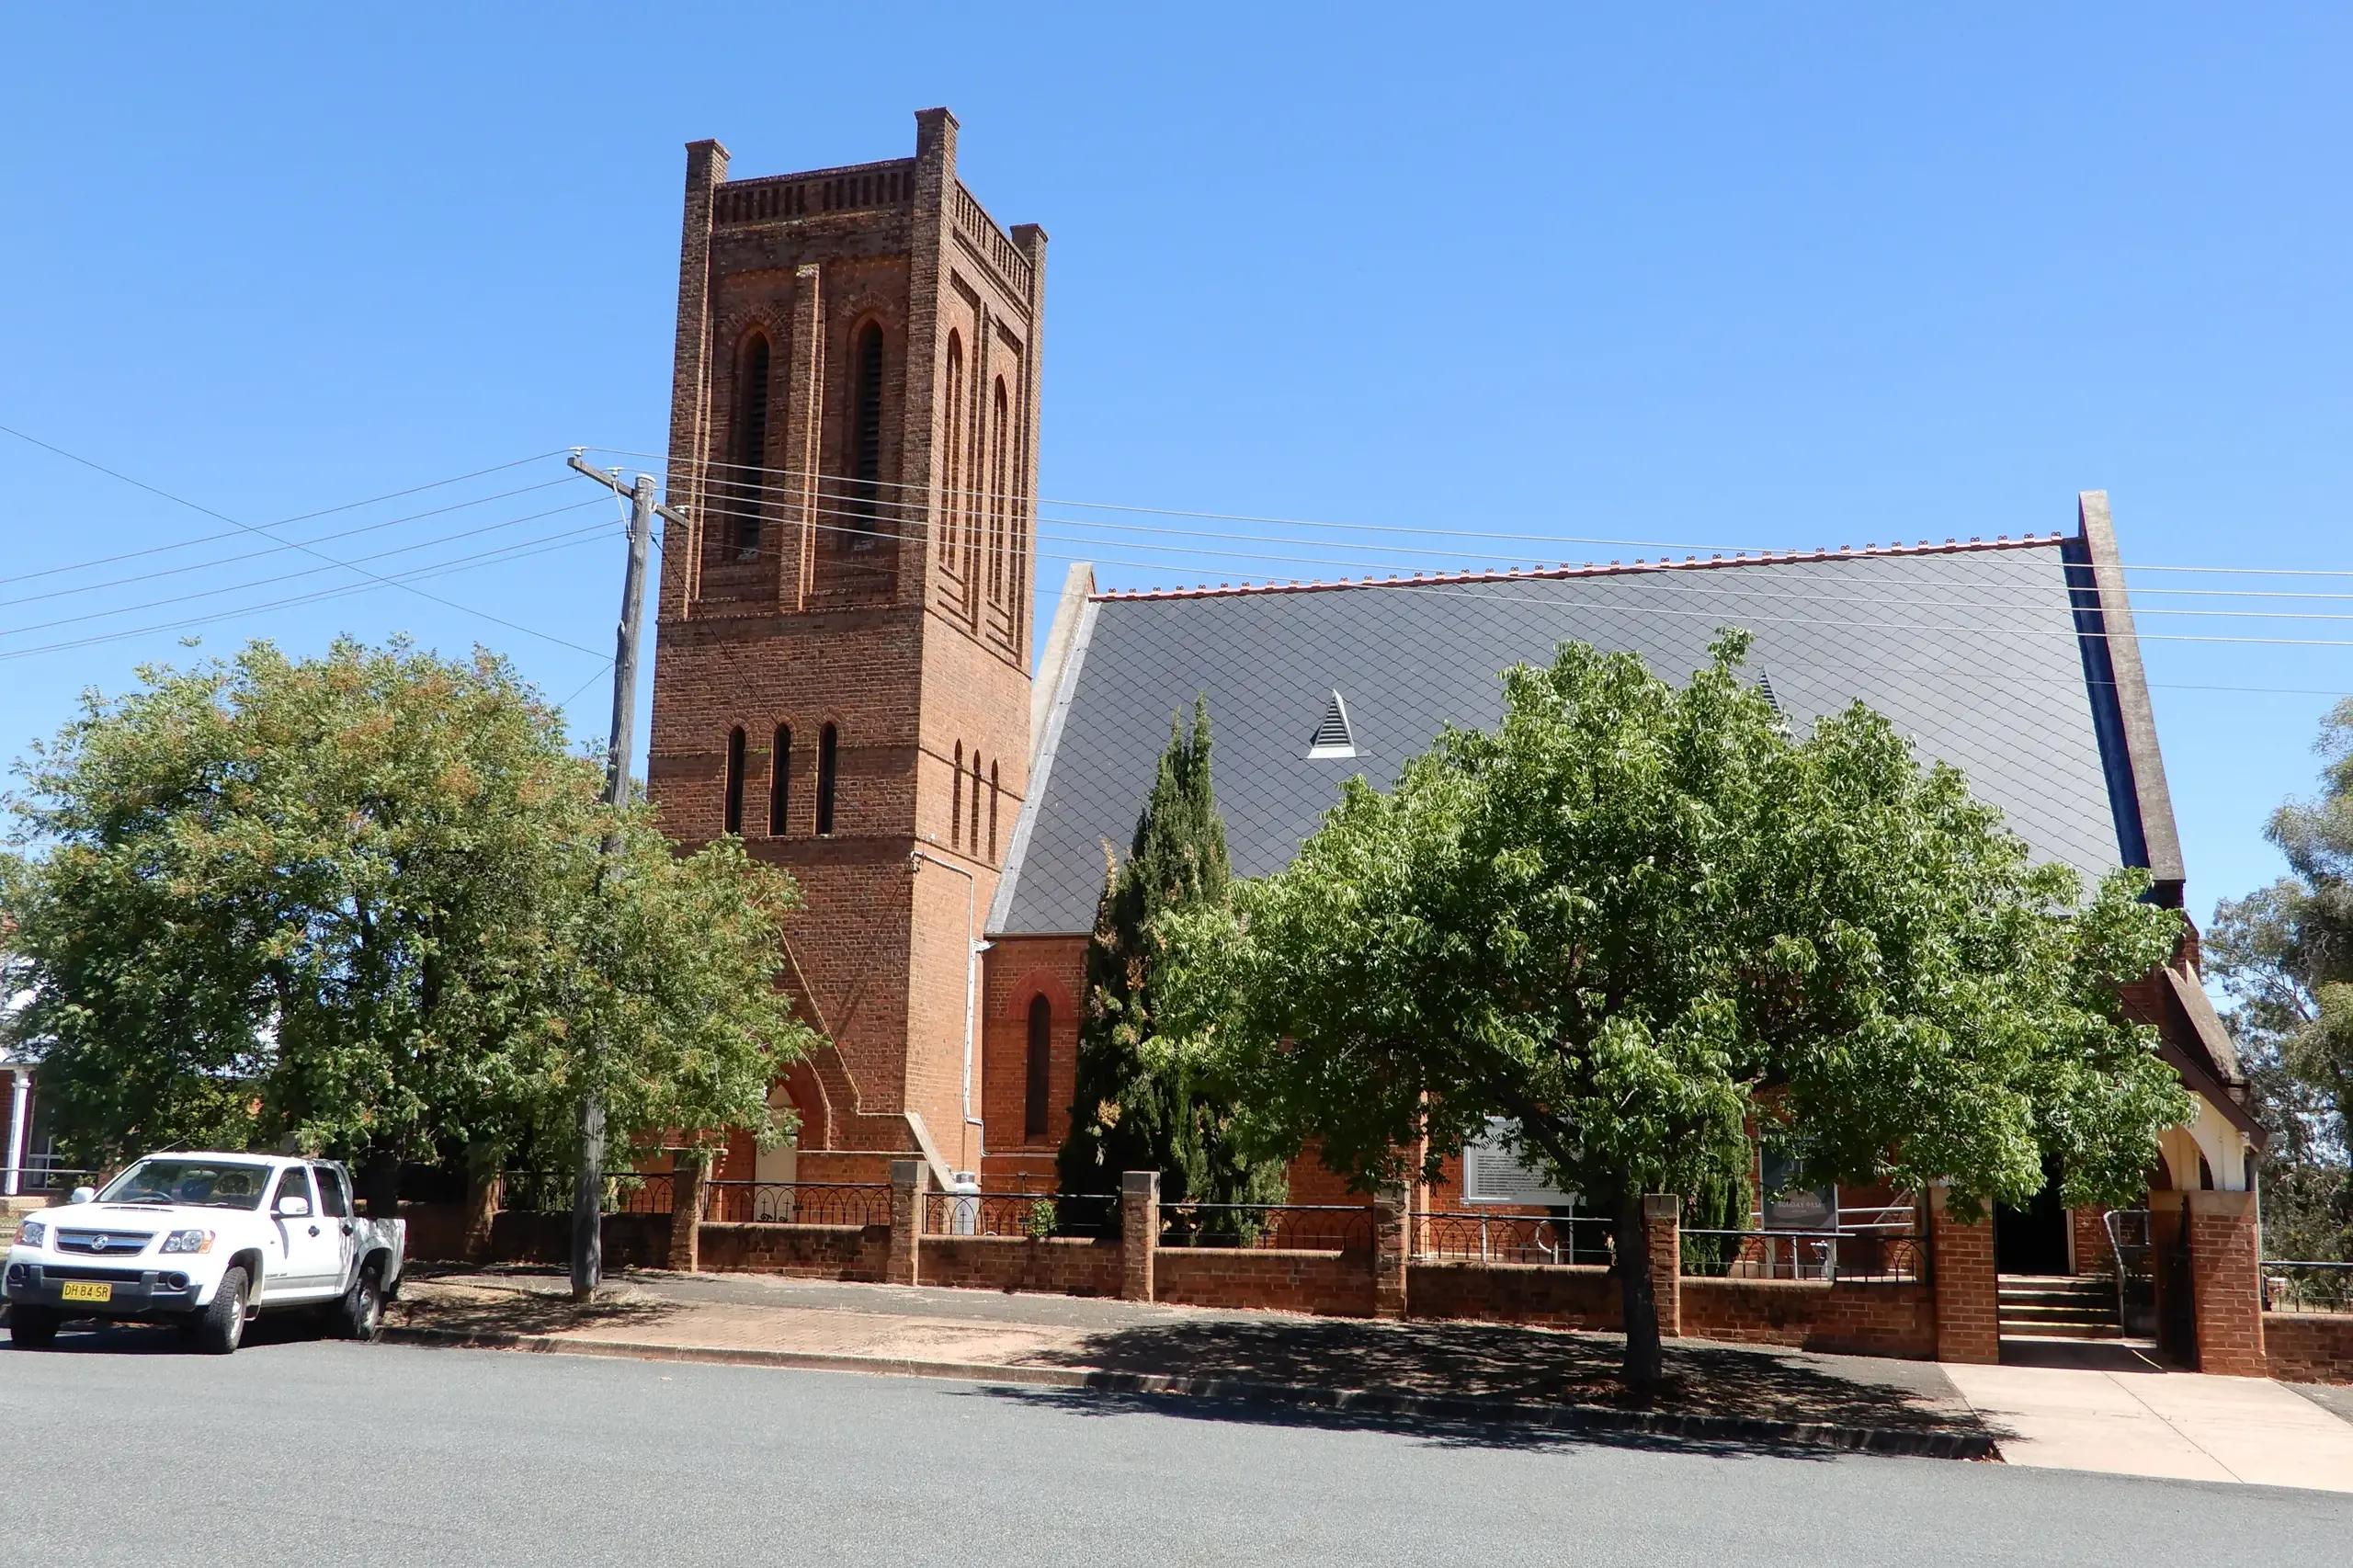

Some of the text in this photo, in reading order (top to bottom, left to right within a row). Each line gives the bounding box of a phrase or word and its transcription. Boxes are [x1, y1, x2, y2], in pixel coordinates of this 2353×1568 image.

[64, 1285, 108, 1298] DH 84 SR
